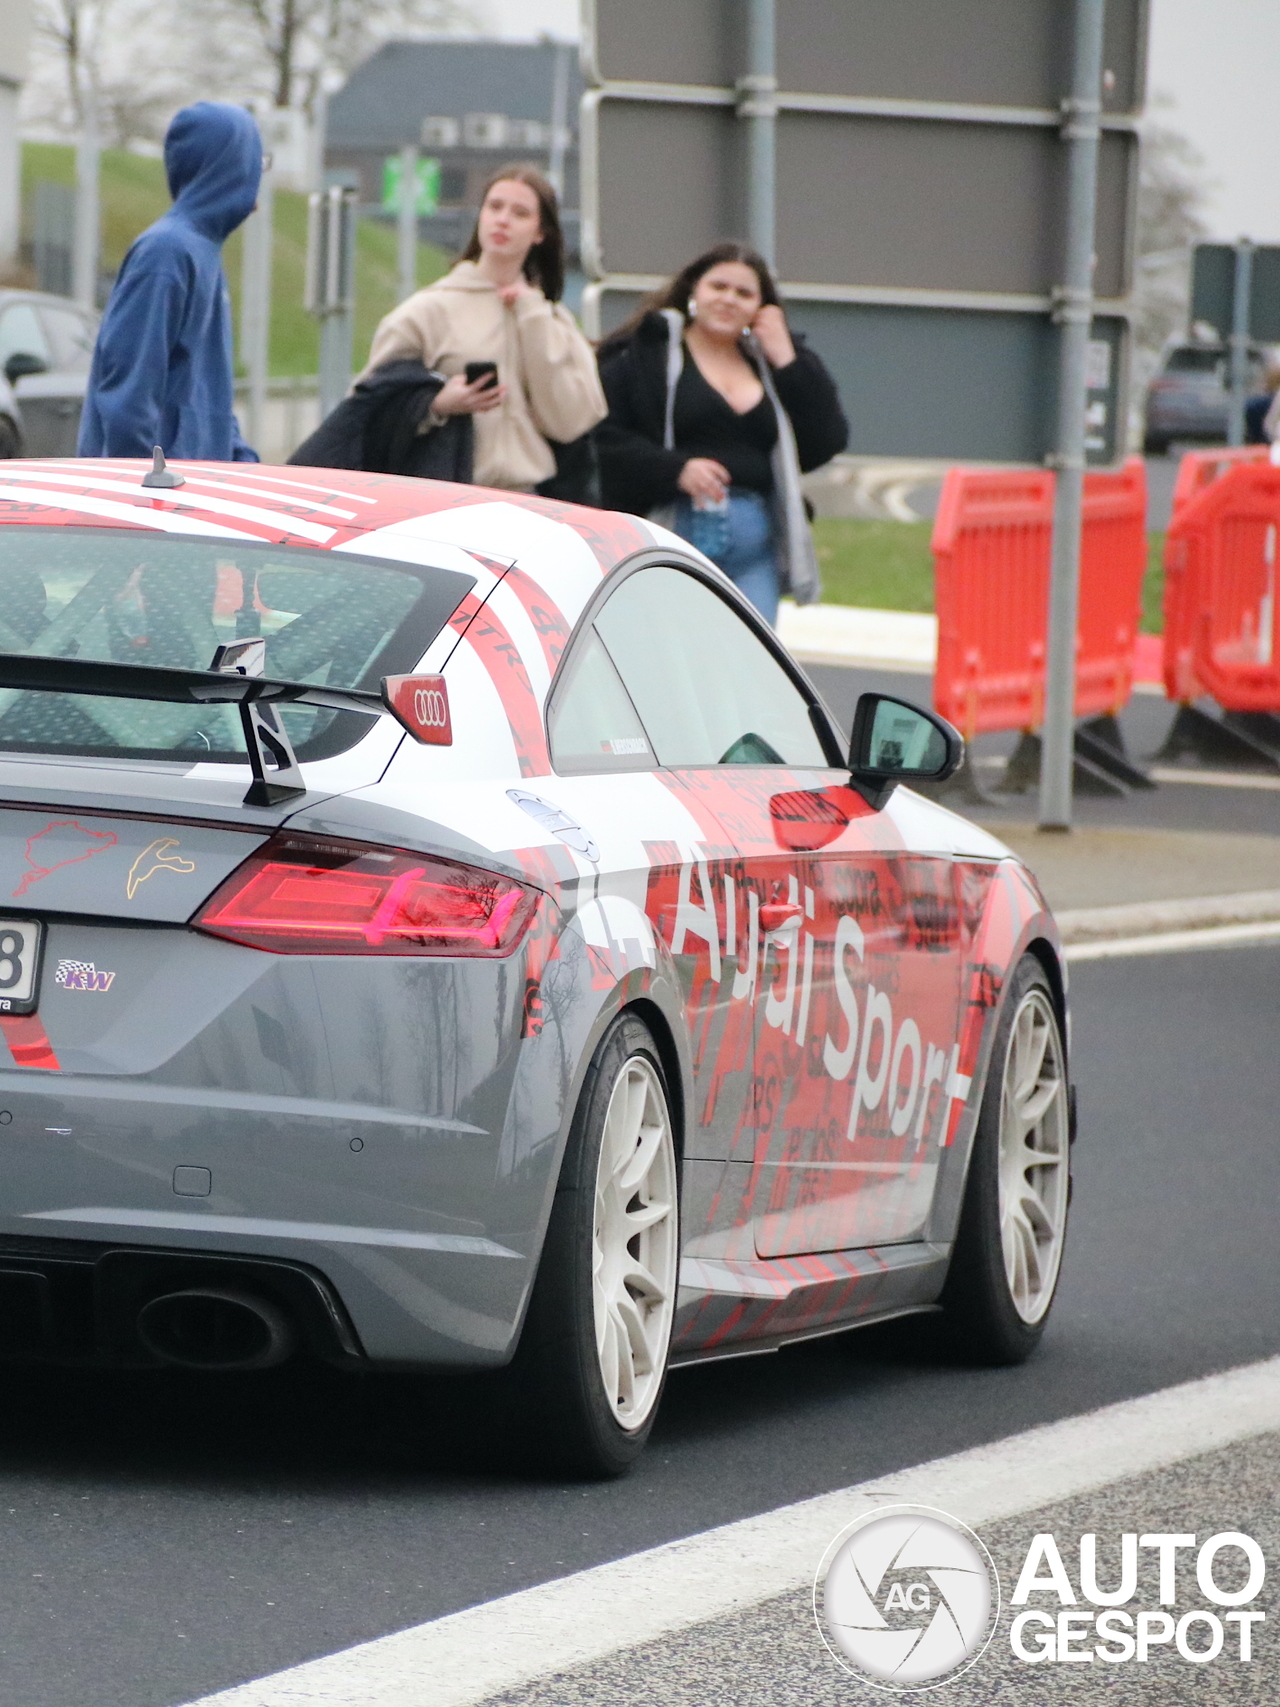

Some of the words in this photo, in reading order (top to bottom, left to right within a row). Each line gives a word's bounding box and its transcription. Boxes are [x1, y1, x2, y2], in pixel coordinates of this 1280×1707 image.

[63, 971, 116, 992] KW
[671, 841, 814, 1047] Audi
[823, 915, 972, 1153] Sport
